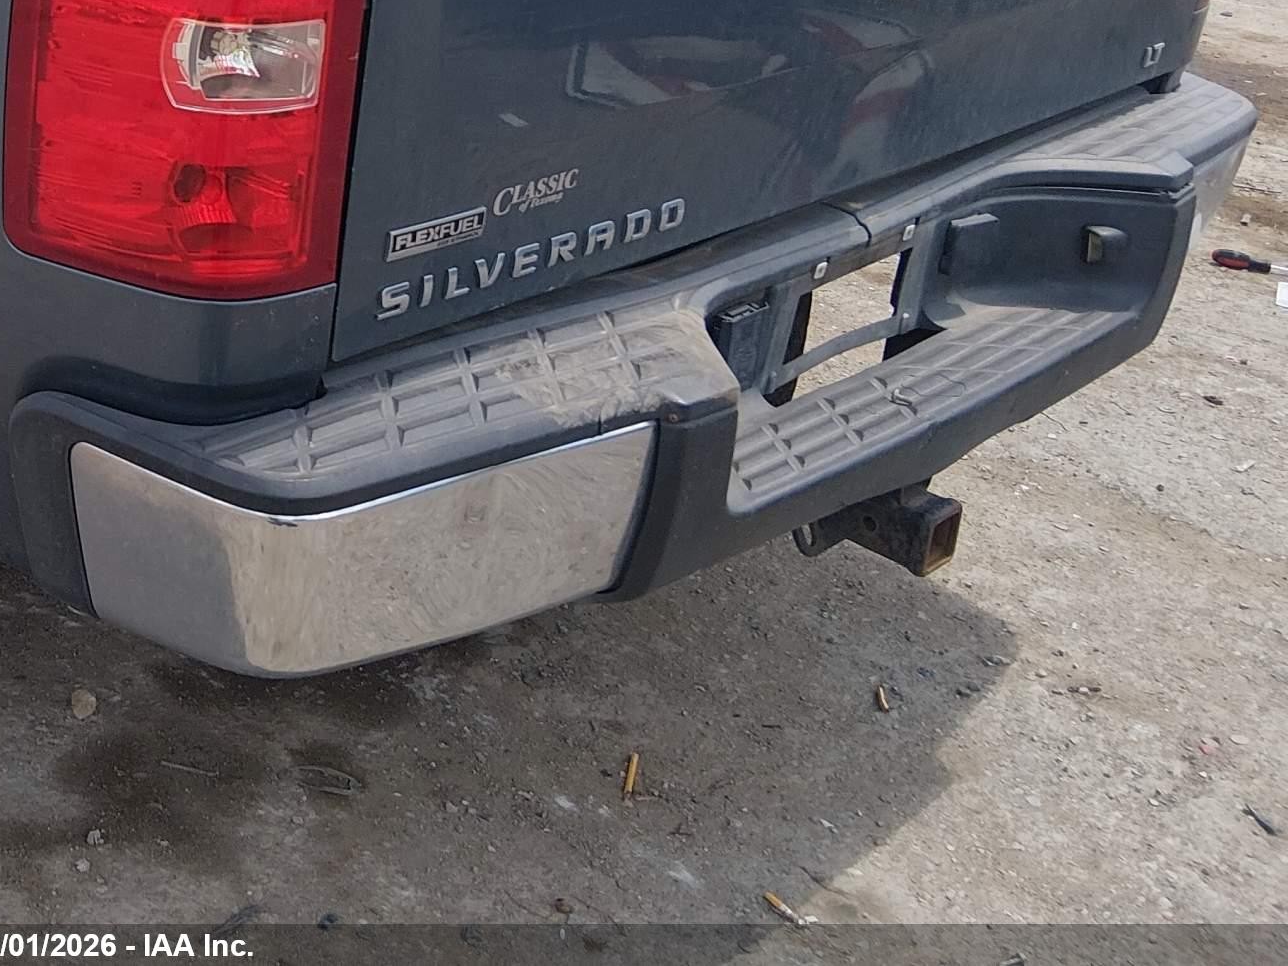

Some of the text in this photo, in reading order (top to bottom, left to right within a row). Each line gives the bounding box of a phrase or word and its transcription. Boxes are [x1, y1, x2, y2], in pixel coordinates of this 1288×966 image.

[1143, 42, 1165, 68] LT
[493, 168, 579, 216] CLASSIC
[395, 215, 482, 251] FLEXFUEL
[377, 198, 686, 321] SILVERADO
